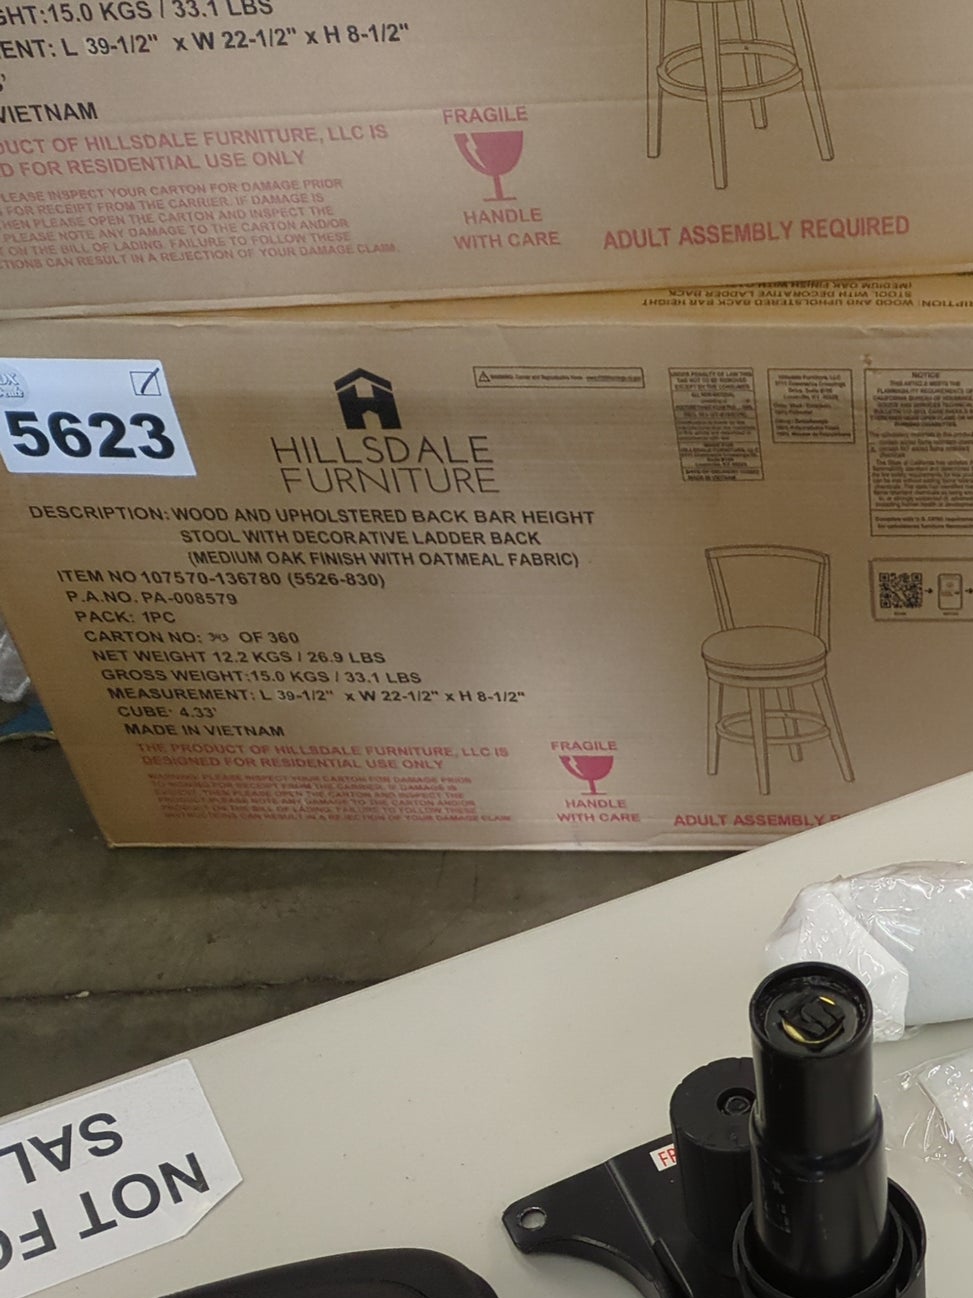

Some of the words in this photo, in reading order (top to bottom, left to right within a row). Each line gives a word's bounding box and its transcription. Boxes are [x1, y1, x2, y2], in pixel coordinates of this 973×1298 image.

[100, 0, 152, 21] KGS
[174, 0, 219, 18] 33.1
[227, 0, 273, 16] LBS
[0, 39, 56, 58] ENT:
[61, 38, 78, 57] L
[85, 34, 158, 55] 39-1/2"
[173, 37, 188, 51] x
[192, 32, 215, 50] W
[221, 27, 296, 49] 22-1/2"
[305, 30, 319, 45] x
[323, 25, 341, 44] H
[347, 22, 409, 43] 8-1/2"
[442, 106, 529, 125] FRAGILE
[0, 139, 45, 154] UCT
[52, 137, 78, 152] OF
[84, 132, 198, 151] HILLSDALE
[203, 127, 324, 146] FURNITURE,
[327, 125, 364, 141] LLC
[369, 124, 389, 139] IS
[19, 161, 63, 176] FOR
[66, 154, 201, 175] RESIDENTIAL
[204, 152, 247, 168] USE
[252, 150, 304, 166] ONLY
[108, 187, 146, 198] YOUR
[150, 184, 207, 195] CARTON
[303, 178, 343, 189] PRIOR
[463, 207, 543, 225] HANDLE
[453, 234, 503, 250] WITH
[507, 230, 560, 247] CARE
[603, 227, 671, 250] ADULT
[679, 221, 793, 245] ASSEMBLY
[800, 215, 910, 239] REQUIRED
[4, 411, 175, 459] 5623
[271, 435, 494, 464] HILLSDALE
[280, 467, 500, 494] FURNITURE
[29, 506, 169, 521] DESCRIPTION:
[171, 508, 228, 521] WOOD
[234, 509, 271, 522] AND
[275, 509, 407, 523] UPHOLSTERED
[412, 510, 468, 523] BACK
[475, 511, 516, 523] BAR
[522, 511, 594, 525] HEIGHT
[180, 530, 240, 543] STOOL
[243, 530, 288, 543] WITH
[293, 531, 408, 544] DECORATIVE
[412, 532, 484, 545] LADDER
[491, 532, 541, 545] BACK
[188, 551, 262, 567] (MEDIUM
[267, 552, 305, 565] OAK
[310, 552, 366, 565] FINISH
[370, 553, 414, 565] WITH
[419, 553, 503, 566] OATMEAL
[508, 553, 579, 568] FABRIC)
[57, 570, 104, 582] ITEM
[108, 571, 136, 583] NO
[141, 571, 281, 585] 107570-136780
[288, 573, 385, 588] (5526-830)
[141, 592, 238, 605] PA-008579
[75, 611, 134, 623] PACK:
[142, 612, 175, 624] 1PC
[84, 631, 163, 642] CARTON
[169, 632, 201, 643] NO:
[239, 632, 262, 643] OF
[269, 632, 298, 644] 360
[92, 651, 127, 662] NET
[135, 651, 206, 663] WEIGHT
[213, 652, 247, 663] 12.2
[252, 652, 292, 663] KGS
[308, 652, 343, 663] 26.9
[349, 652, 386, 664] LBS
[101, 670, 167, 681] GROSS
[290, 671, 329, 683] KGS
[344, 671, 380, 683] 33.1
[385, 672, 421, 684] LBS
[107, 687, 254, 700] MEASUREMENT:
[260, 690, 272, 700] L
[277, 690, 334, 701] 39-1/2"
[358, 690, 376, 702] W
[381, 690, 438, 702] 22-1/2"
[460, 690, 472, 702] H
[477, 691, 526, 703] 8-1/2"
[124, 724, 178, 735] MADE
[182, 725, 200, 735] IN
[203, 725, 285, 736] VIETNAM
[138, 744, 167, 753] THE
[171, 744, 244, 754] PRODUCT
[250, 745, 271, 754] OF
[275, 745, 361, 755] HILLSDALE
[462, 747, 490, 757] LLC
[495, 747, 509, 757] IS
[551, 741, 618, 751] FRAGILE
[142, 756, 220, 766] DESIGNED
[225, 757, 257, 767] FOR
[261, 757, 361, 769] RESIDENTIAL
[366, 759, 398, 769] USE
[402, 759, 444, 769] ONLY
[566, 799, 627, 809] HANDLE
[556, 813, 596, 823] WITH
[599, 813, 641, 823] CARE
[674, 815, 728, 827] ADULT
[733, 815, 824, 827] ASSEMBLY
[79, 1152, 210, 1240] NOT
